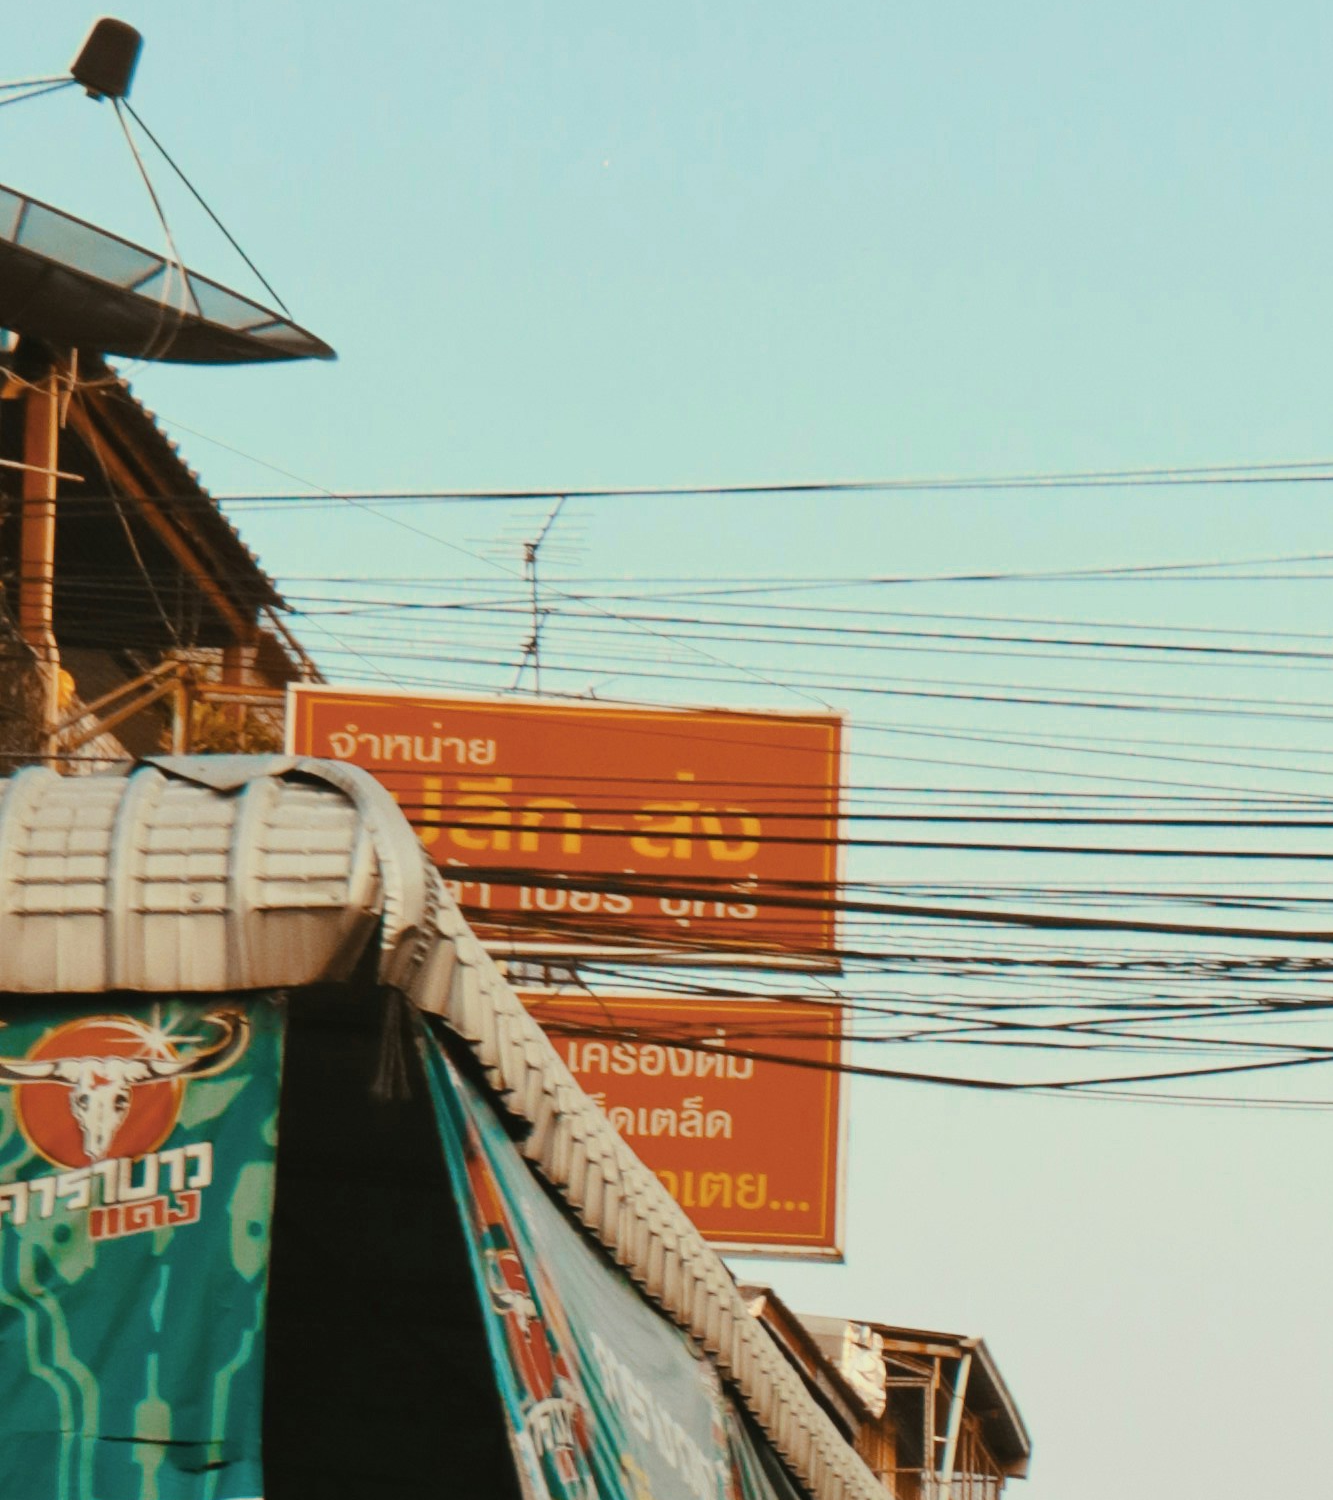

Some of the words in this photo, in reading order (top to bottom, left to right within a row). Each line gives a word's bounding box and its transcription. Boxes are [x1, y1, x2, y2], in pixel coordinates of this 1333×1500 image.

[329, 721, 497, 765] จำหน่าย
[567, 1028, 754, 1080] เครองดื่ม
[587, 1092, 733, 1139] ็ดเตล็ด
[89, 1189, 202, 1242] แดง
